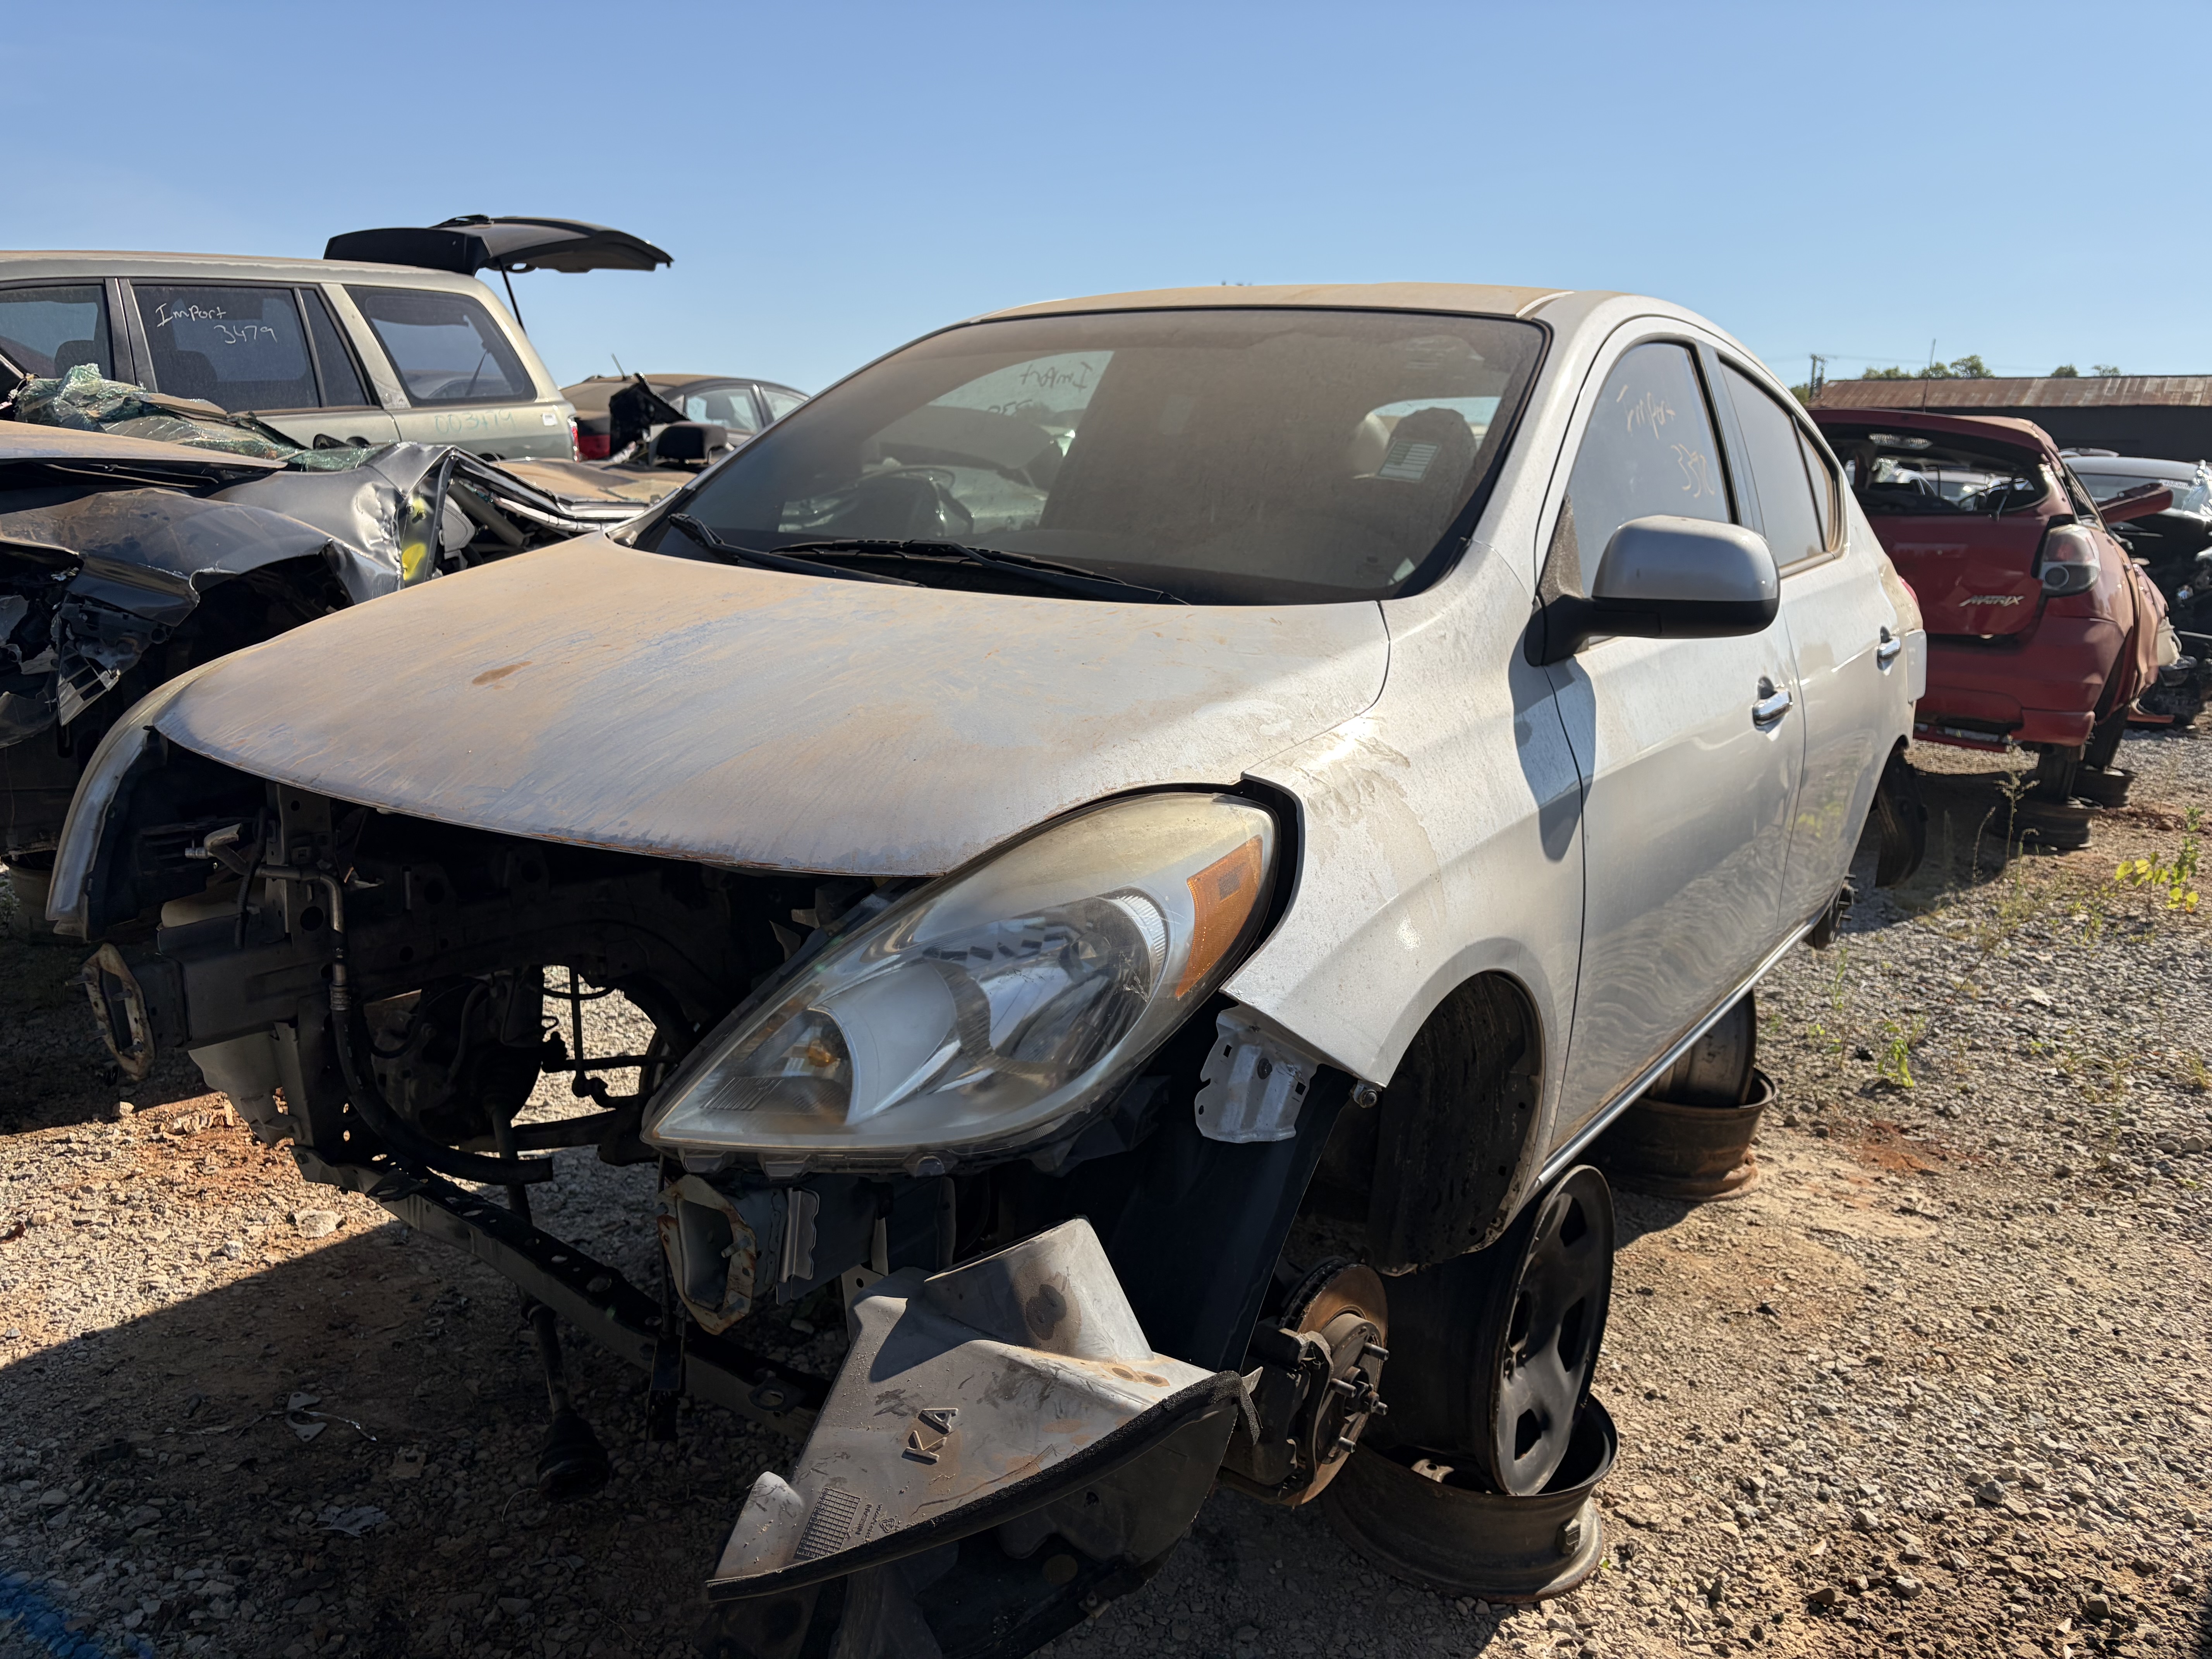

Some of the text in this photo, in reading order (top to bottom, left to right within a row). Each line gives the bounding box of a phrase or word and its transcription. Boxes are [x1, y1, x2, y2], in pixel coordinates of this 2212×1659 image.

[213, 325, 277, 344] 3479
[1958, 595, 2025, 607] MATRIX
[855, 1504, 872, 1535] NISSAN
